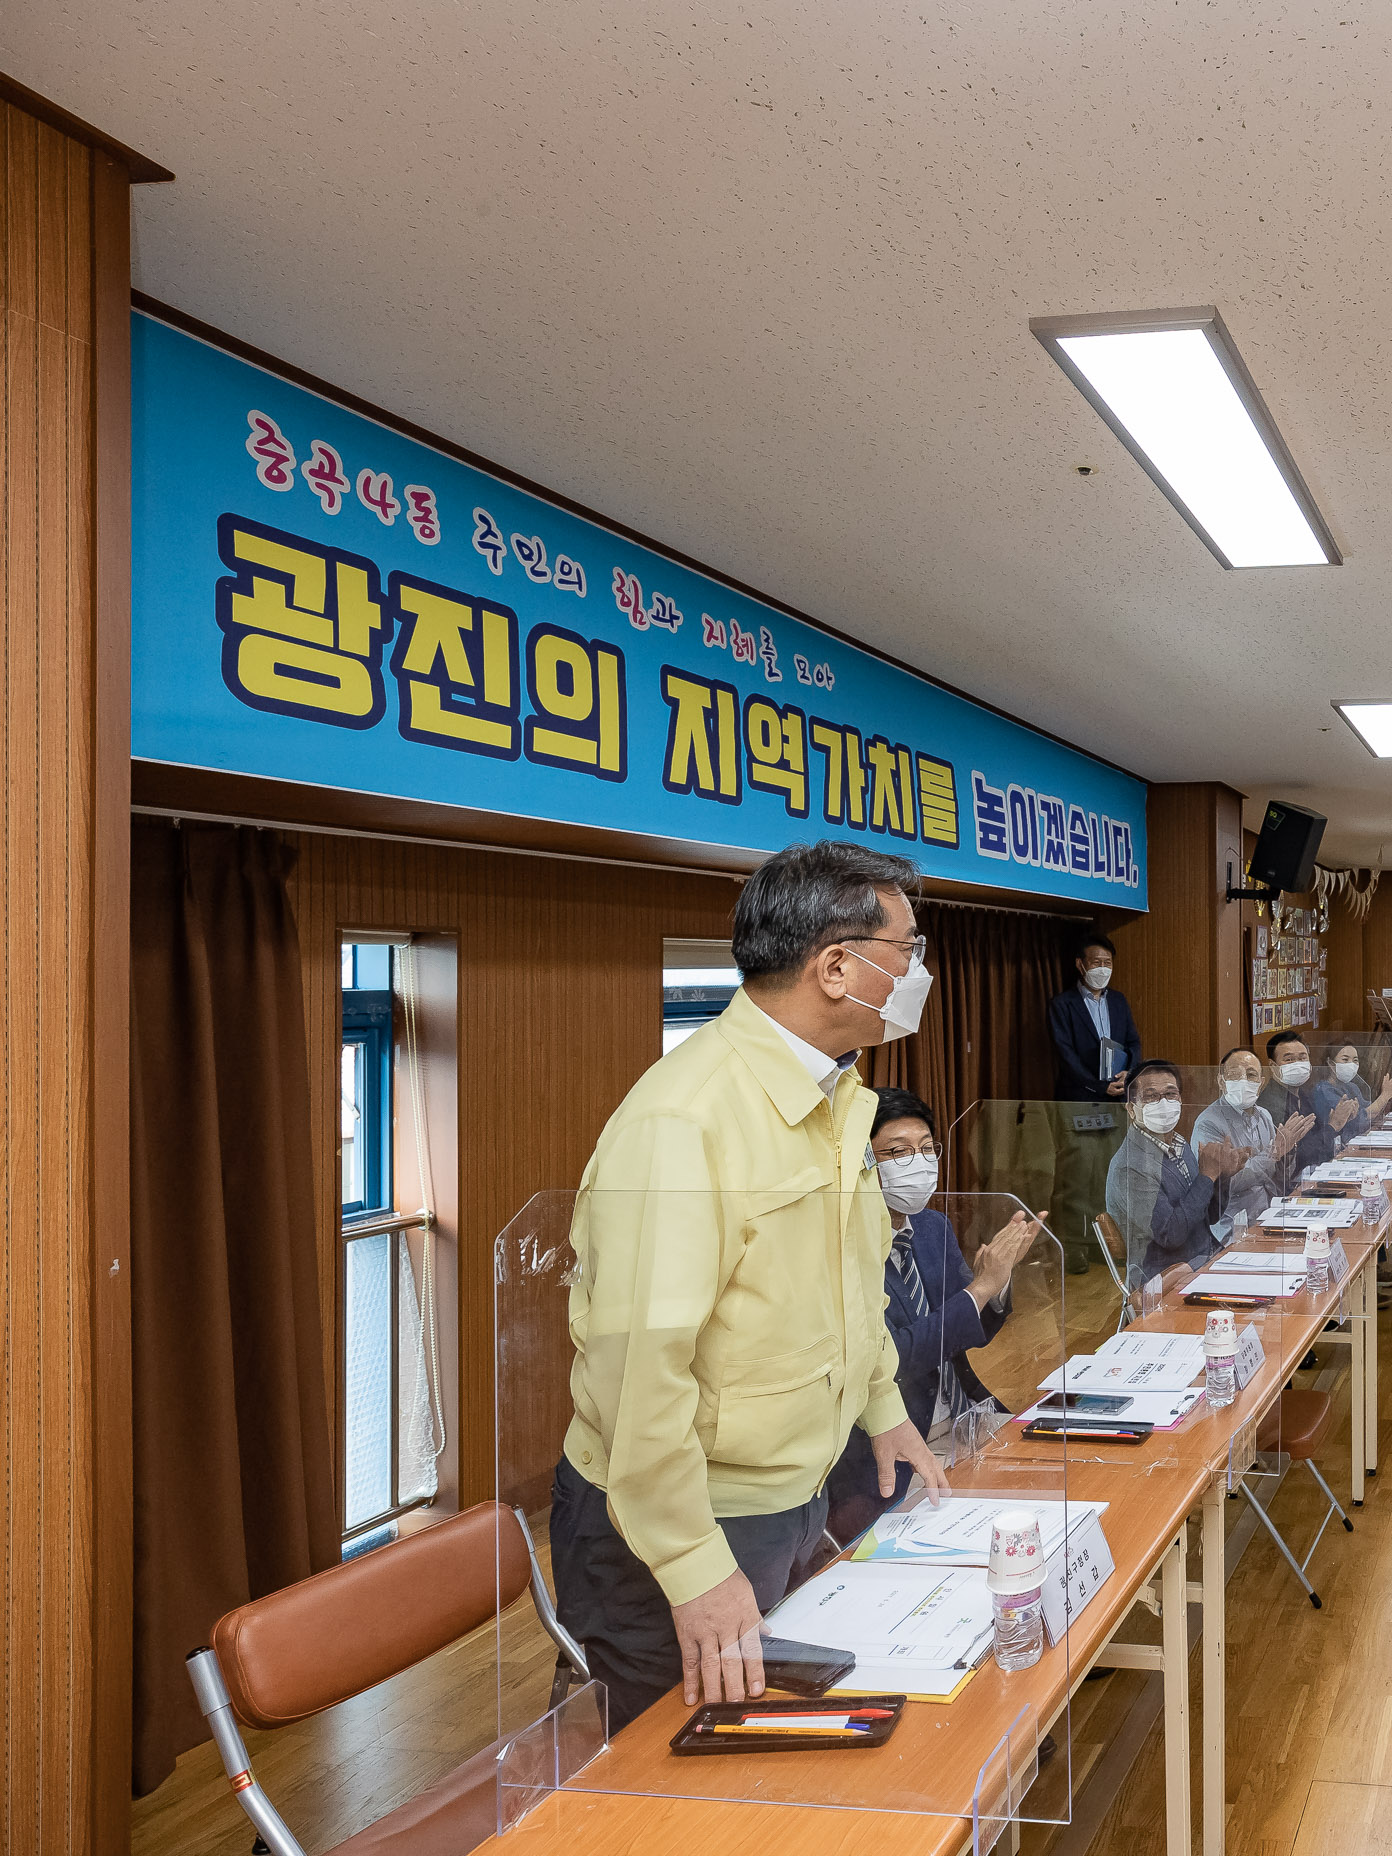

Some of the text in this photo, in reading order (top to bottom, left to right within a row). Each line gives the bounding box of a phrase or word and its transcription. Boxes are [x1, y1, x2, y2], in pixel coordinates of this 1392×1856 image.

[249, 412, 834, 691] 중곡4동 주민의 힘과 지혜를 모아
[219, 515, 1139, 887] 광진의 지역가치를 높이겠습니다.
[1059, 1549, 1090, 1589] 광진구청장
